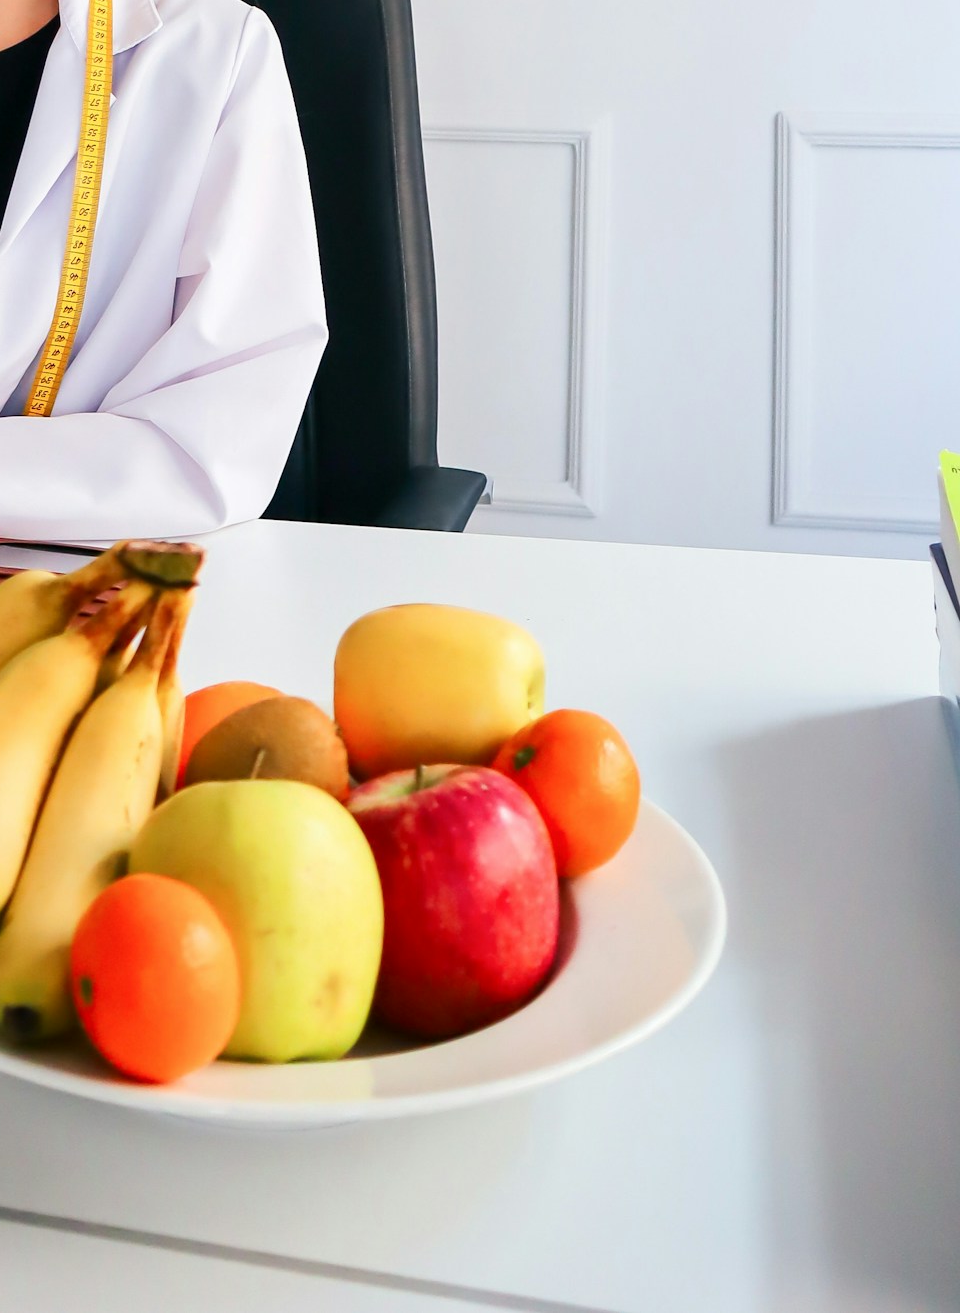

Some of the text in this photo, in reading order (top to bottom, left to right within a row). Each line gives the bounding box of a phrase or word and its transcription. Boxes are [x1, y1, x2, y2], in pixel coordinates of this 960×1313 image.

[90, 98, 100, 106] 57
[85, 144, 96, 152] 54
[84, 160, 94, 168] 53
[82, 176, 92, 184] 52
[79, 208, 90, 216] 50
[32, 403, 44, 411] 37
